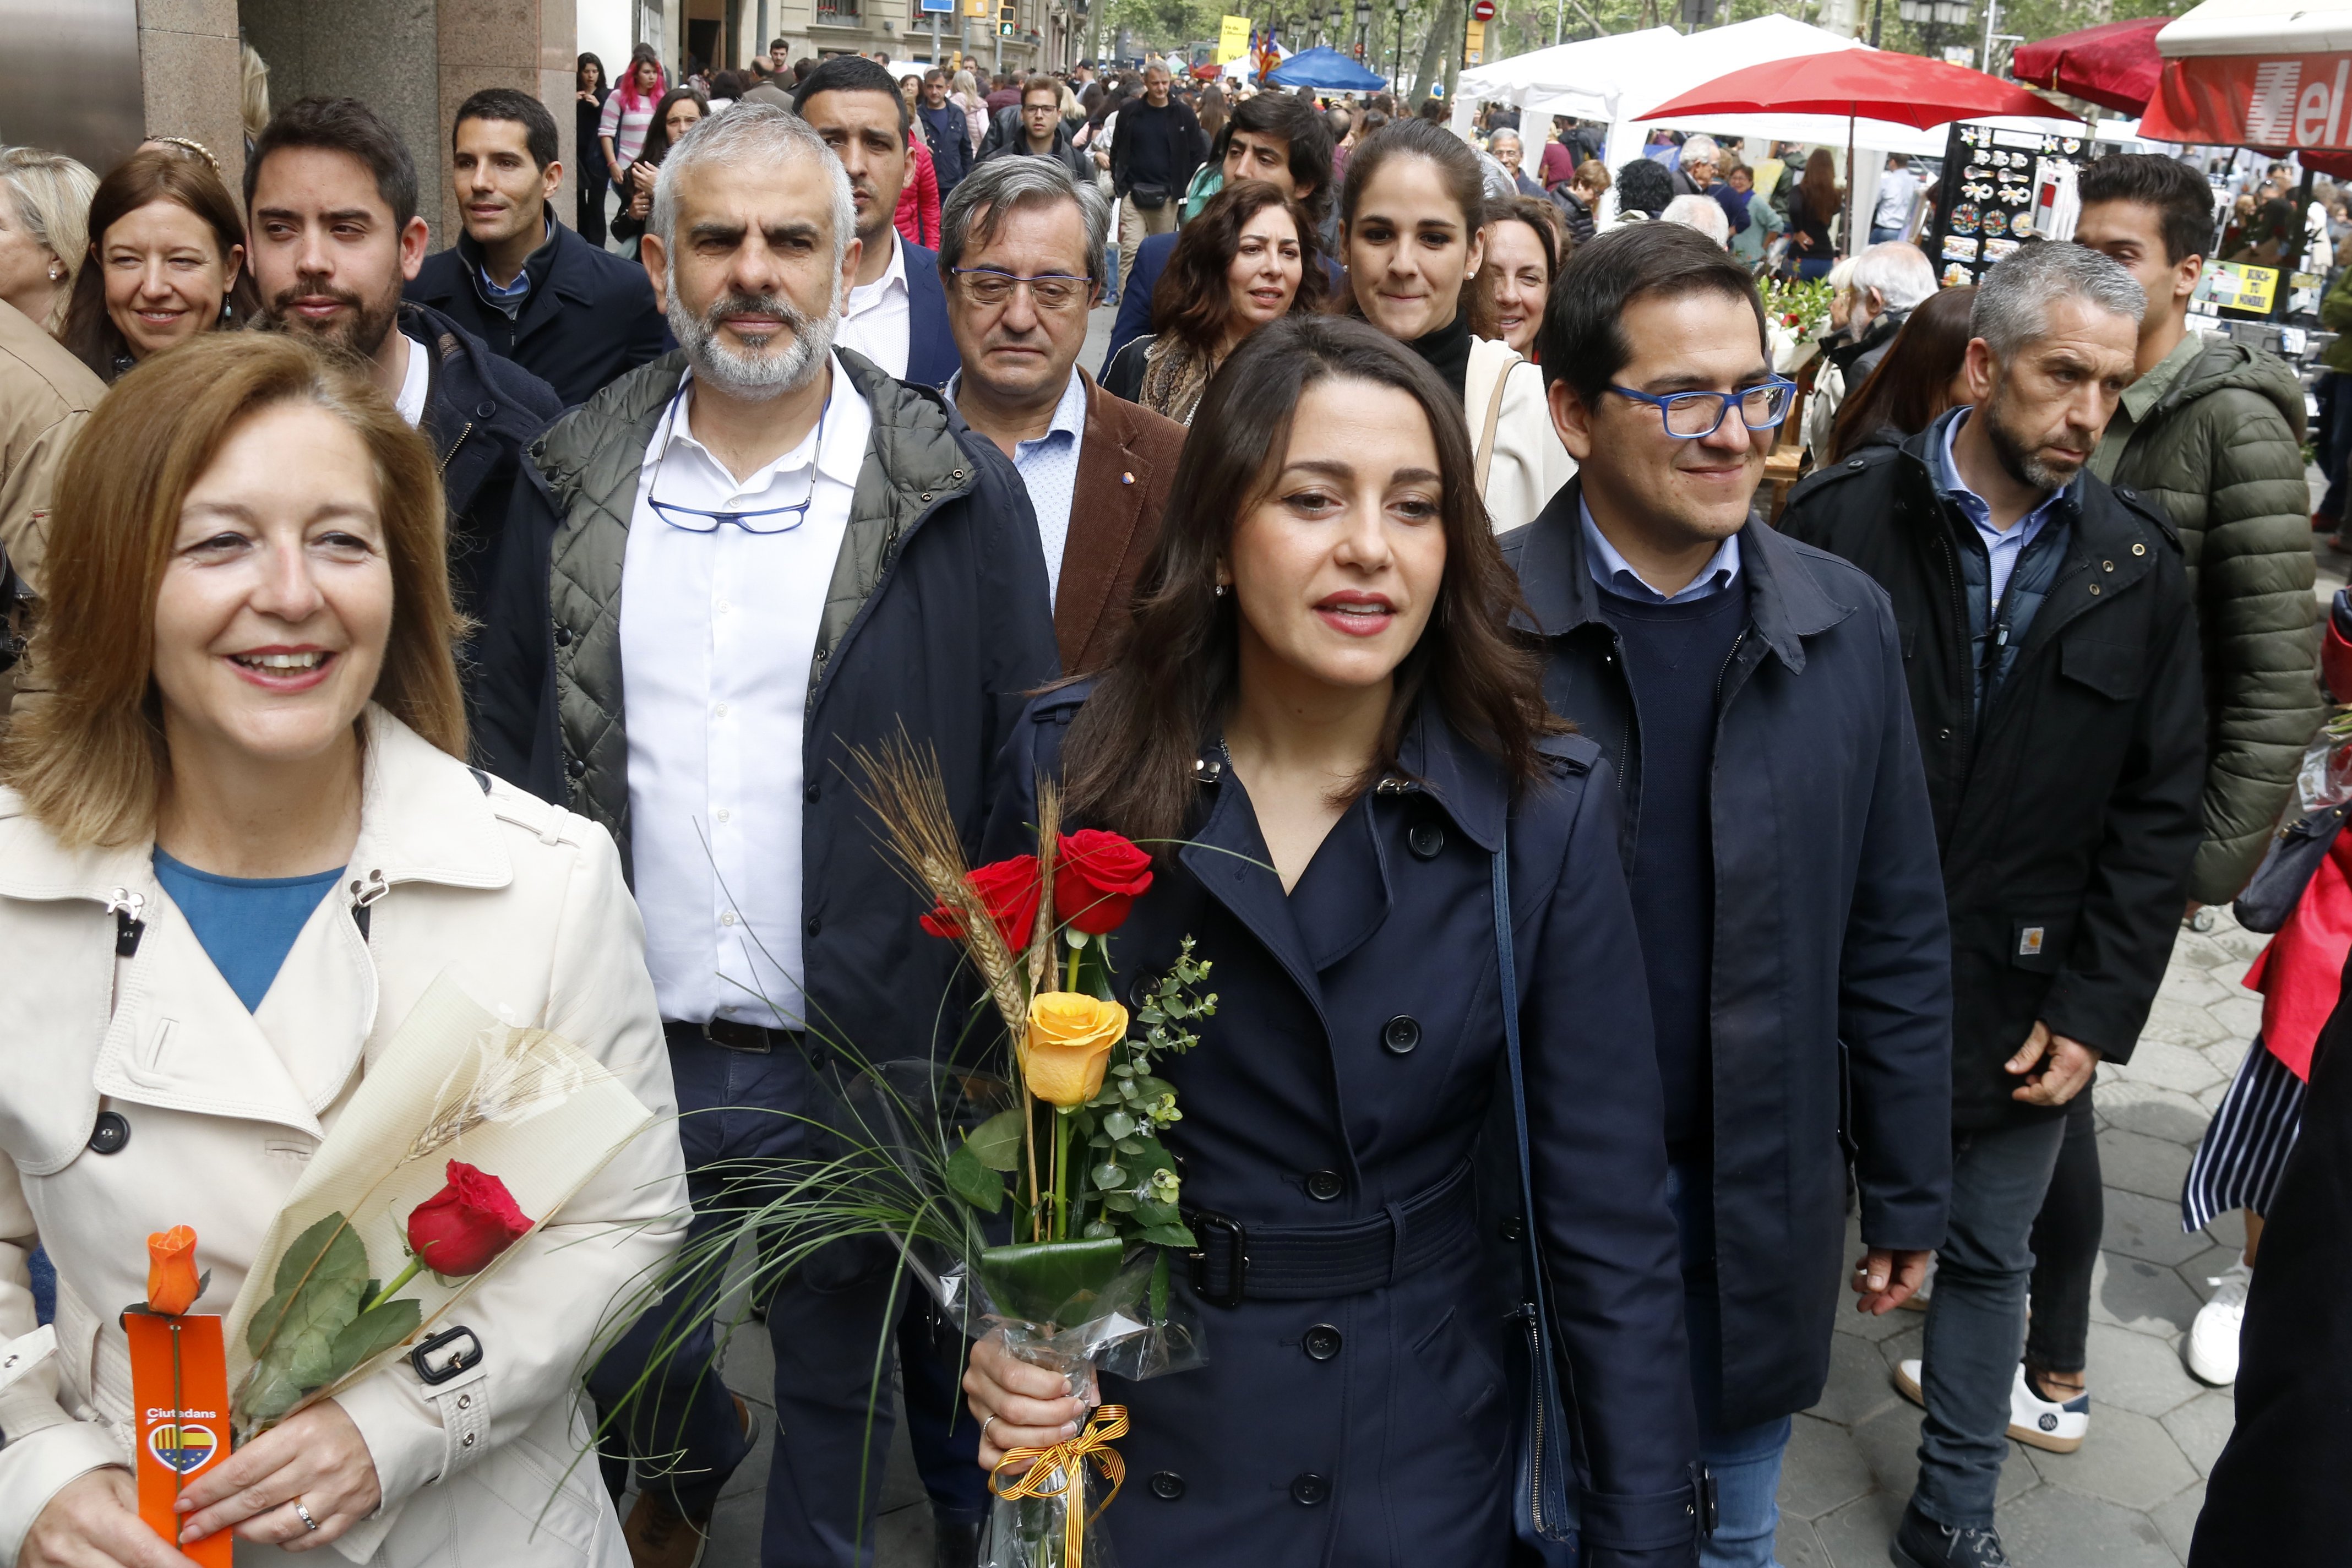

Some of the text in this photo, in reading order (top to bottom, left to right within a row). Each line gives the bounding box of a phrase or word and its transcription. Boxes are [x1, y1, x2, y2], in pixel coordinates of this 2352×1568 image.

[2250, 282, 2261, 293] TU
[2239, 294, 2266, 307] NOMBRE
[147, 1408, 216, 1418] Ciutadans
